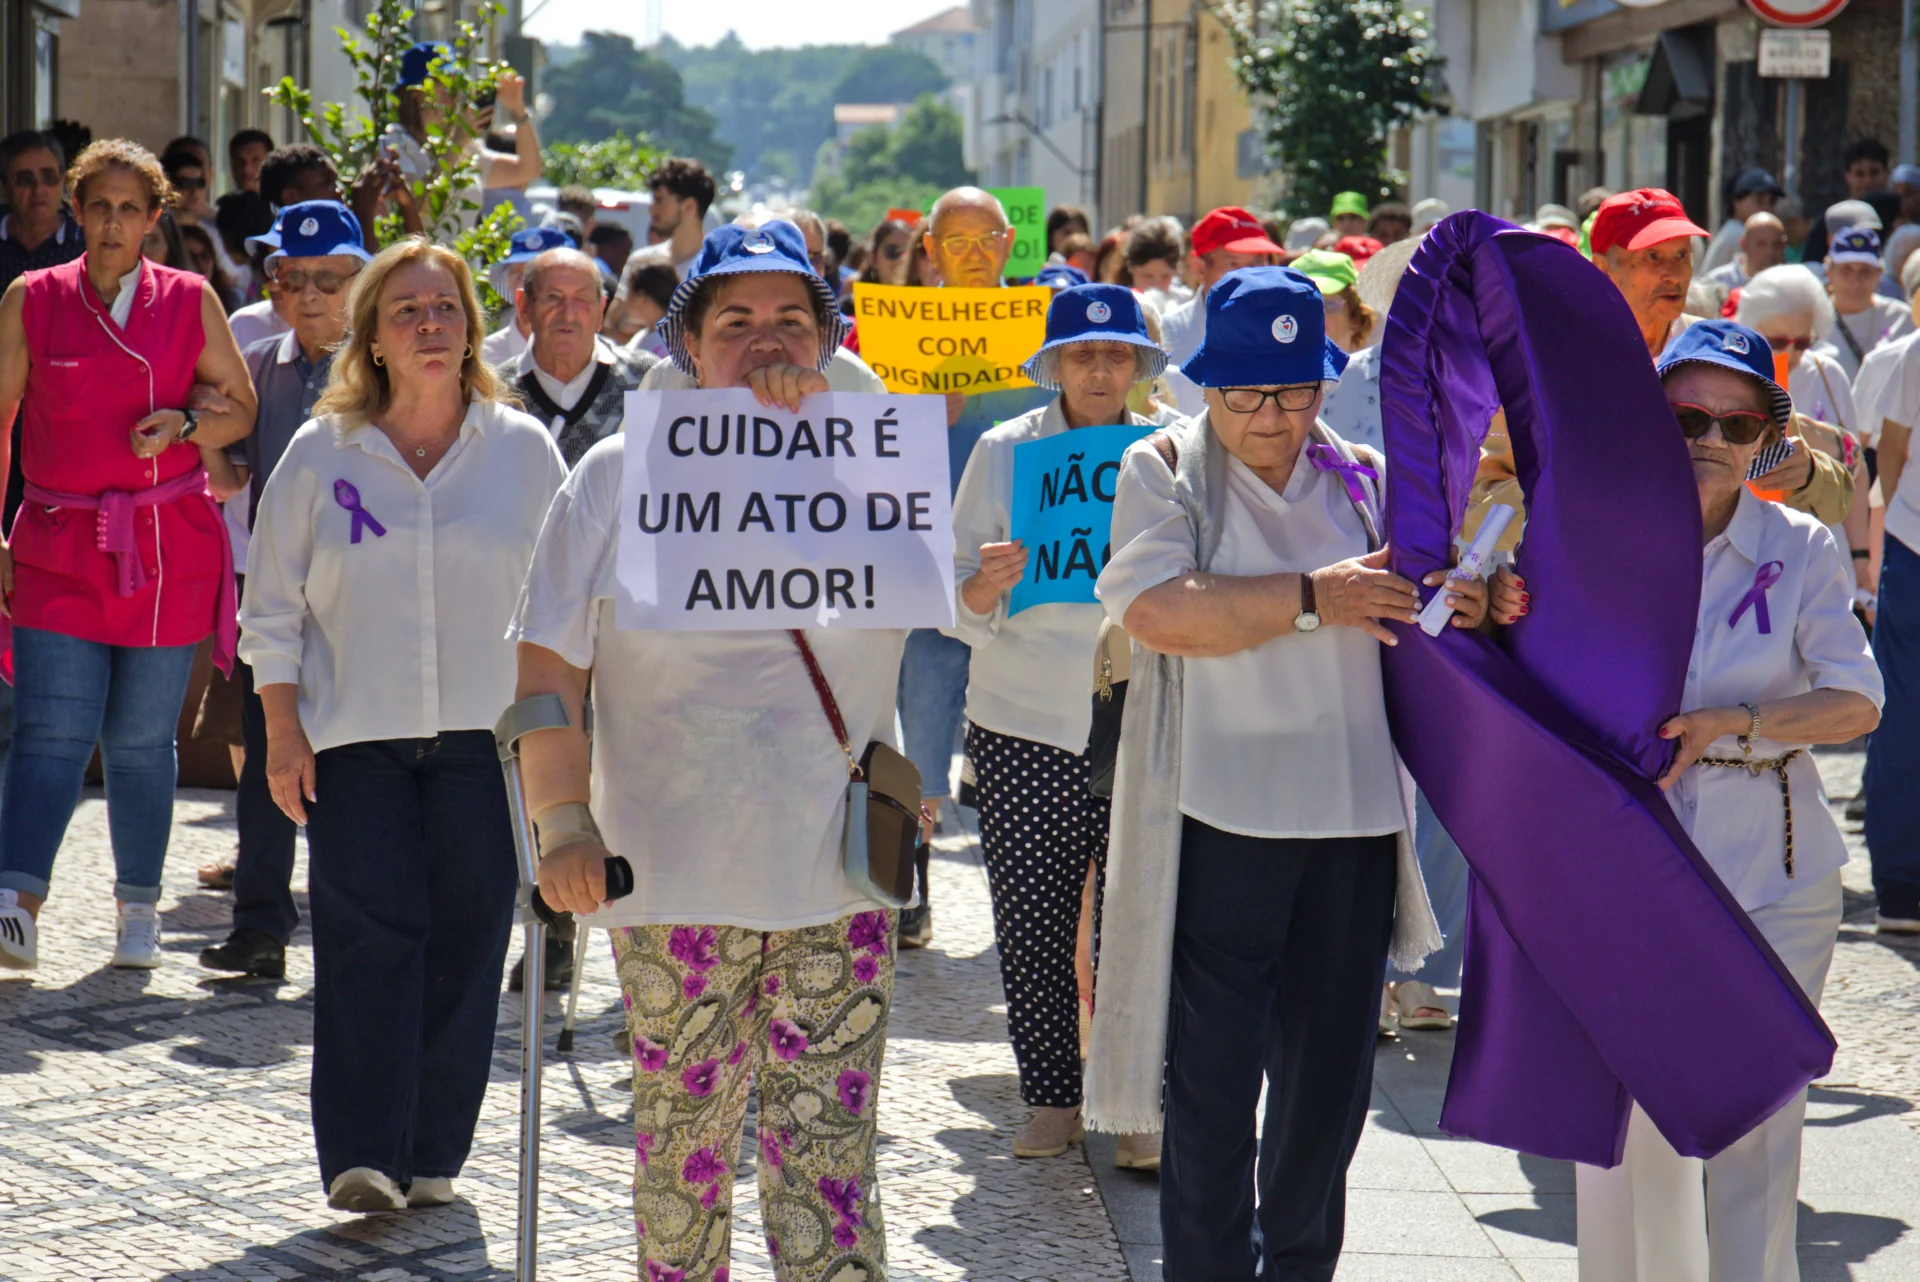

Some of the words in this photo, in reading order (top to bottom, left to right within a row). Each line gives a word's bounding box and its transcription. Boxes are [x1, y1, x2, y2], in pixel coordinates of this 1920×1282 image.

[1009, 205, 1039, 225] DE
[861, 297, 1044, 322] ENVELHECER
[918, 336, 988, 357] COM
[667, 414, 856, 460] CUIDAR
[874, 408, 900, 458] É
[1039, 452, 1121, 513] NÃO
[638, 491, 721, 534] UM
[738, 491, 847, 533] ATO
[866, 491, 933, 532] DE
[685, 564, 875, 611] AMOR!
